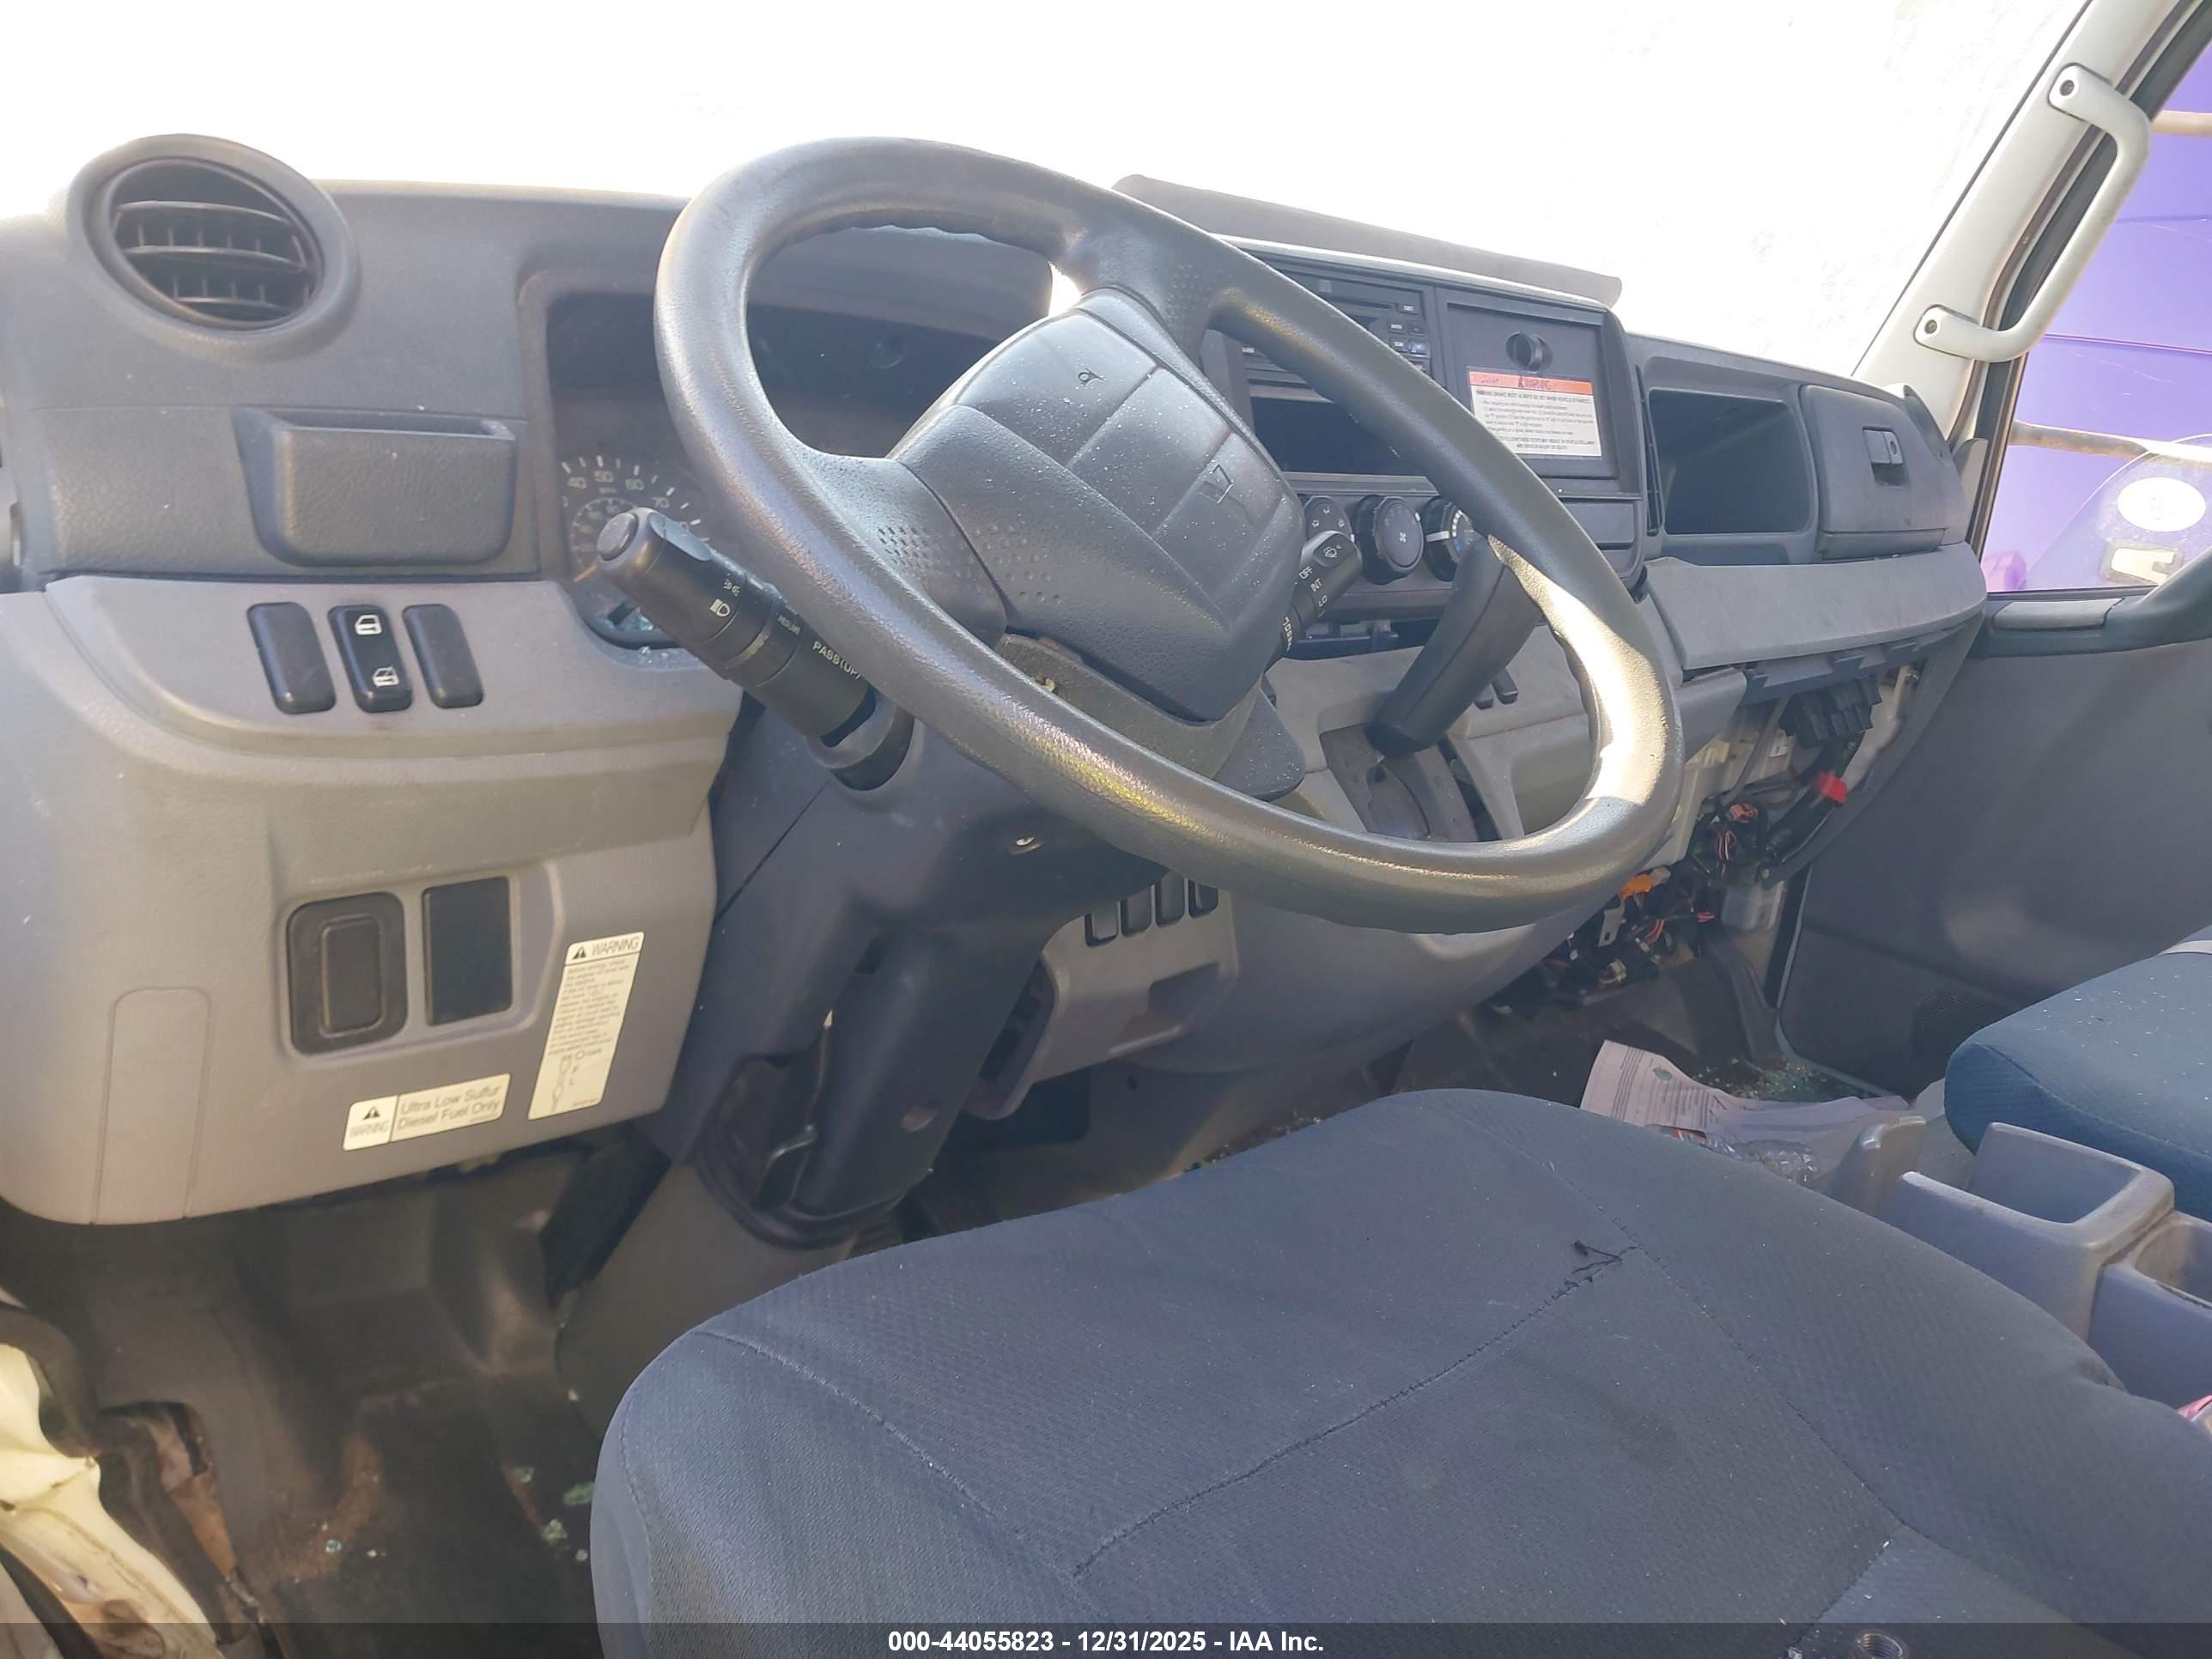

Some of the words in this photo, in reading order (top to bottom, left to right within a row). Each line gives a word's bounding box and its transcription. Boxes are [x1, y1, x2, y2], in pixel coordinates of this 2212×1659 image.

[593, 470, 614, 483] 50
[625, 478, 644, 491] 60
[652, 496, 670, 509] 70
[1298, 565, 1313, 580] OFF
[1310, 577, 1323, 592] INT
[401, 1100, 432, 1115] Ultra
[434, 1095, 459, 1108] Low
[465, 1085, 501, 1101] Sulfur
[398, 1113, 437, 1131] Diesel
[441, 1104, 469, 1121] Fuel
[472, 1098, 501, 1115] Only
